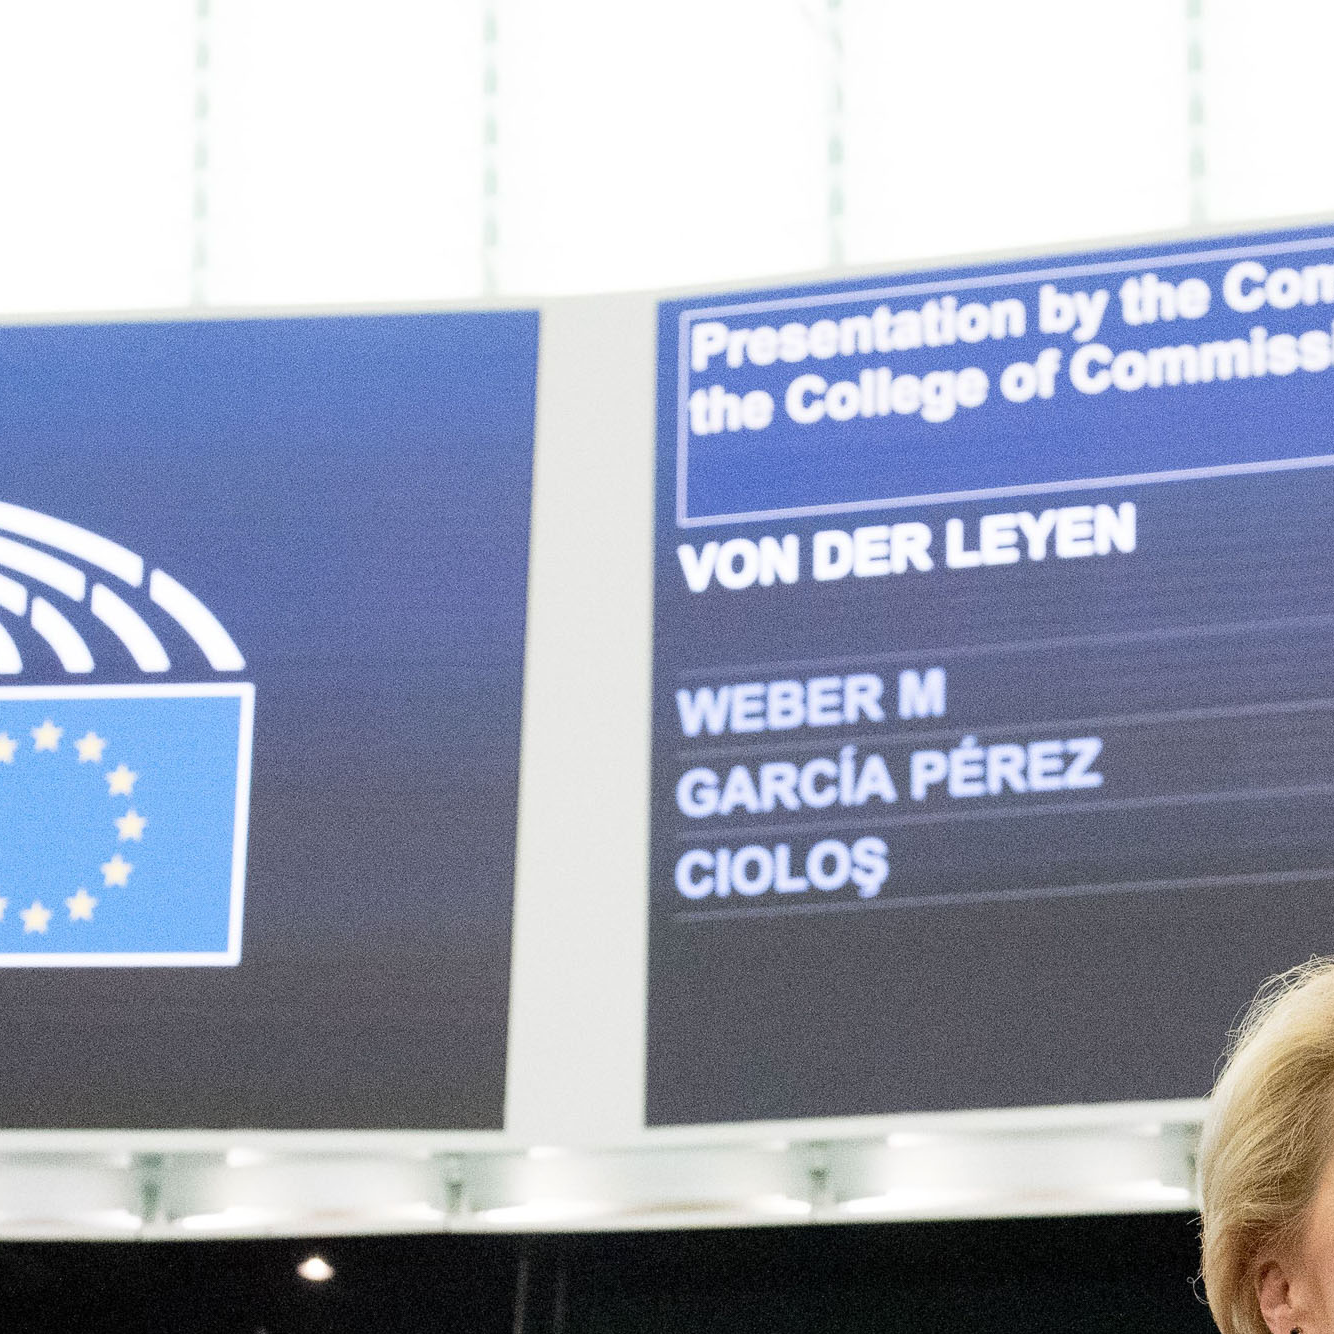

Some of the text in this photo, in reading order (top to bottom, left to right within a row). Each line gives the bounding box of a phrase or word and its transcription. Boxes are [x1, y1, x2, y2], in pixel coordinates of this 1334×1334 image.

[688, 293, 1028, 373] Presentation
[1038, 284, 1110, 343] by
[1118, 272, 1212, 326] the
[687, 385, 775, 437] the
[785, 366, 990, 424] College
[999, 347, 1062, 403] of
[677, 502, 1137, 593] VON DER LEYEN
[676, 668, 946, 736] WEBER M
[676, 736, 1102, 818] GARCÍA PÉREZ
[675, 837, 889, 899] CIOLOŞ
